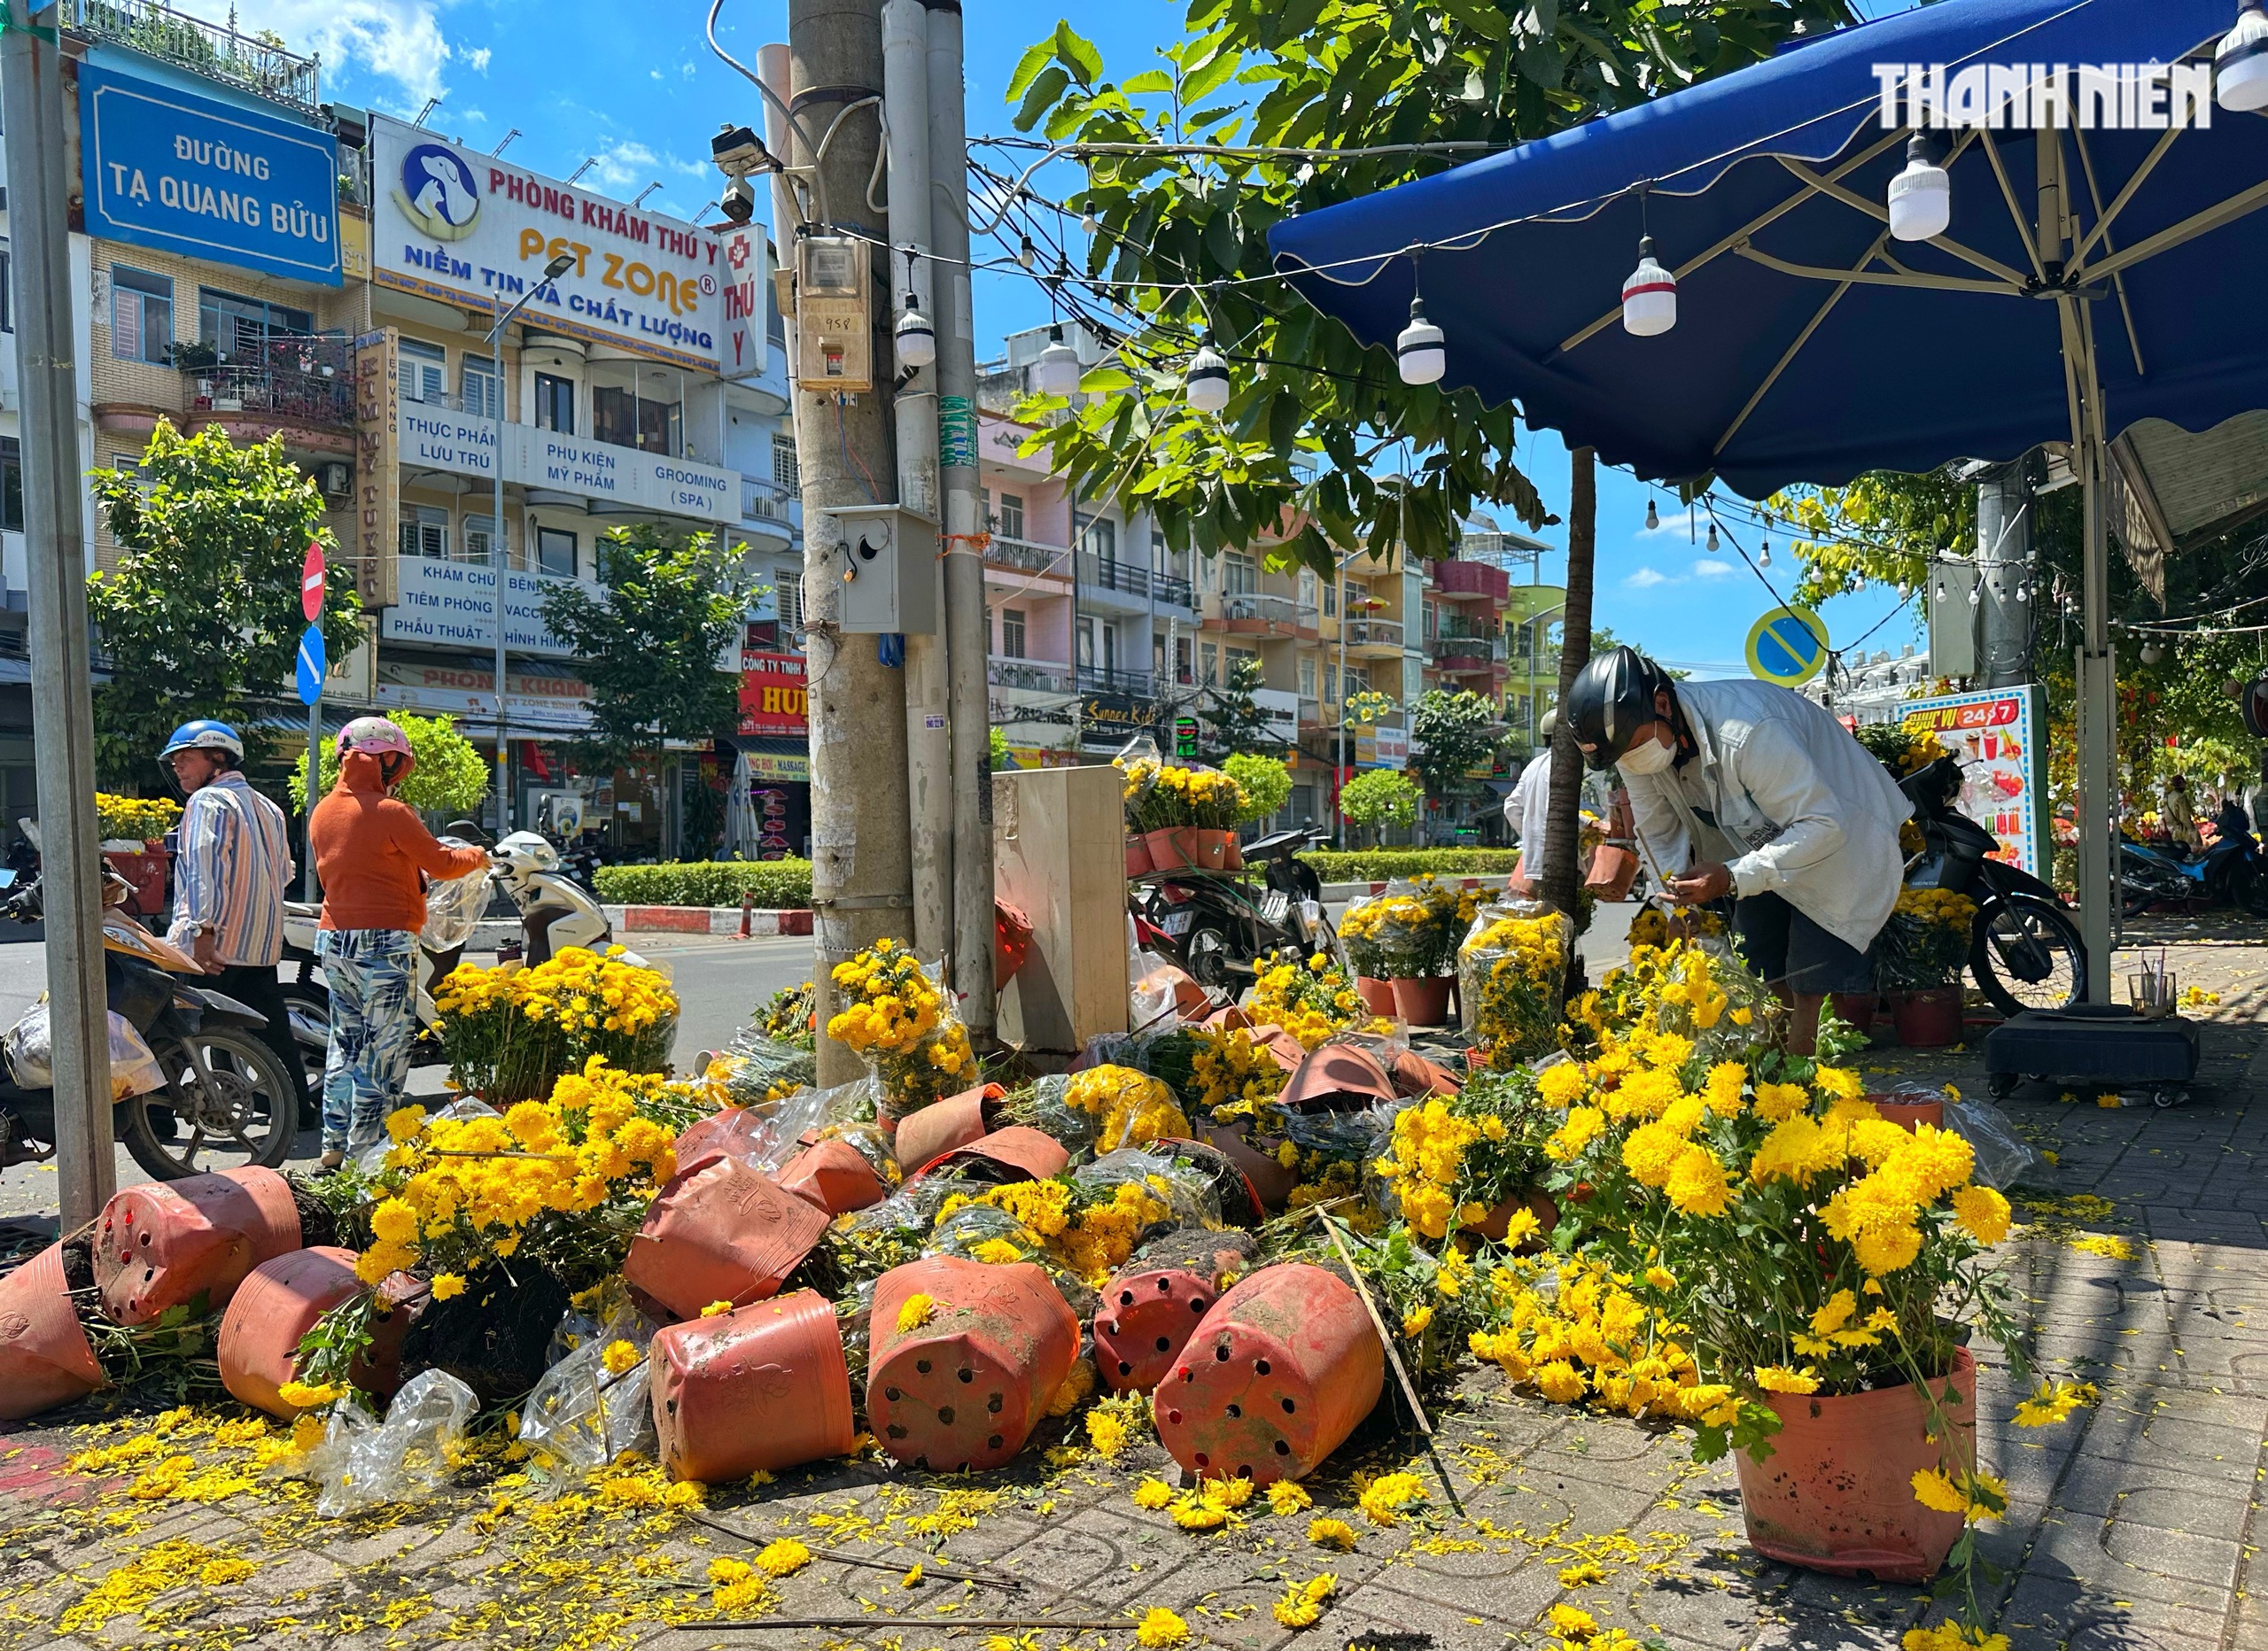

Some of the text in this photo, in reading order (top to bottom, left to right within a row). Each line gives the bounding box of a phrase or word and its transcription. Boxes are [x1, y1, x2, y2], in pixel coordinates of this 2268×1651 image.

[174, 135, 269, 181] ĐƯỜNG
[109, 162, 328, 244] TẠ QUANG BỬU
[489, 167, 718, 265] PHÒNG KHÁM THÚ Y
[404, 244, 471, 281] NIỀM
[480, 267, 524, 295] TIN
[532, 281, 562, 307] VÀ
[569, 294, 633, 327] CHẤT
[640, 314, 712, 350] LƯỢNG
[724, 273, 755, 366] THÚ Y
[826, 317, 850, 331] 958
[388, 334, 397, 433] TIỆM VÀNG
[406, 415, 452, 438] THỰC
[420, 442, 490, 469] LƯU TRÚ
[547, 444, 616, 470] PHỤ KIỆN
[548, 464, 615, 491] MỸ PHẨM
[655, 466, 727, 492] GROOMING
[679, 492, 705, 508] SPA
[423, 566, 463, 583] KHÁM
[468, 570, 497, 586] CHỮ
[406, 592, 548, 620] TIÊM PHÒNG VACCI
[394, 617, 434, 635] PHẪU
[437, 624, 484, 642] THUẬT
[496, 630, 537, 647] HỈNH
[742, 655, 765, 671] CÔNG
[767, 660, 778, 673] TY
[781, 661, 801, 677] TNHH
[521, 675, 588, 698] KHÁM
[1087, 700, 1129, 723] Sunnee
[777, 759, 806, 773] MASSAGE
